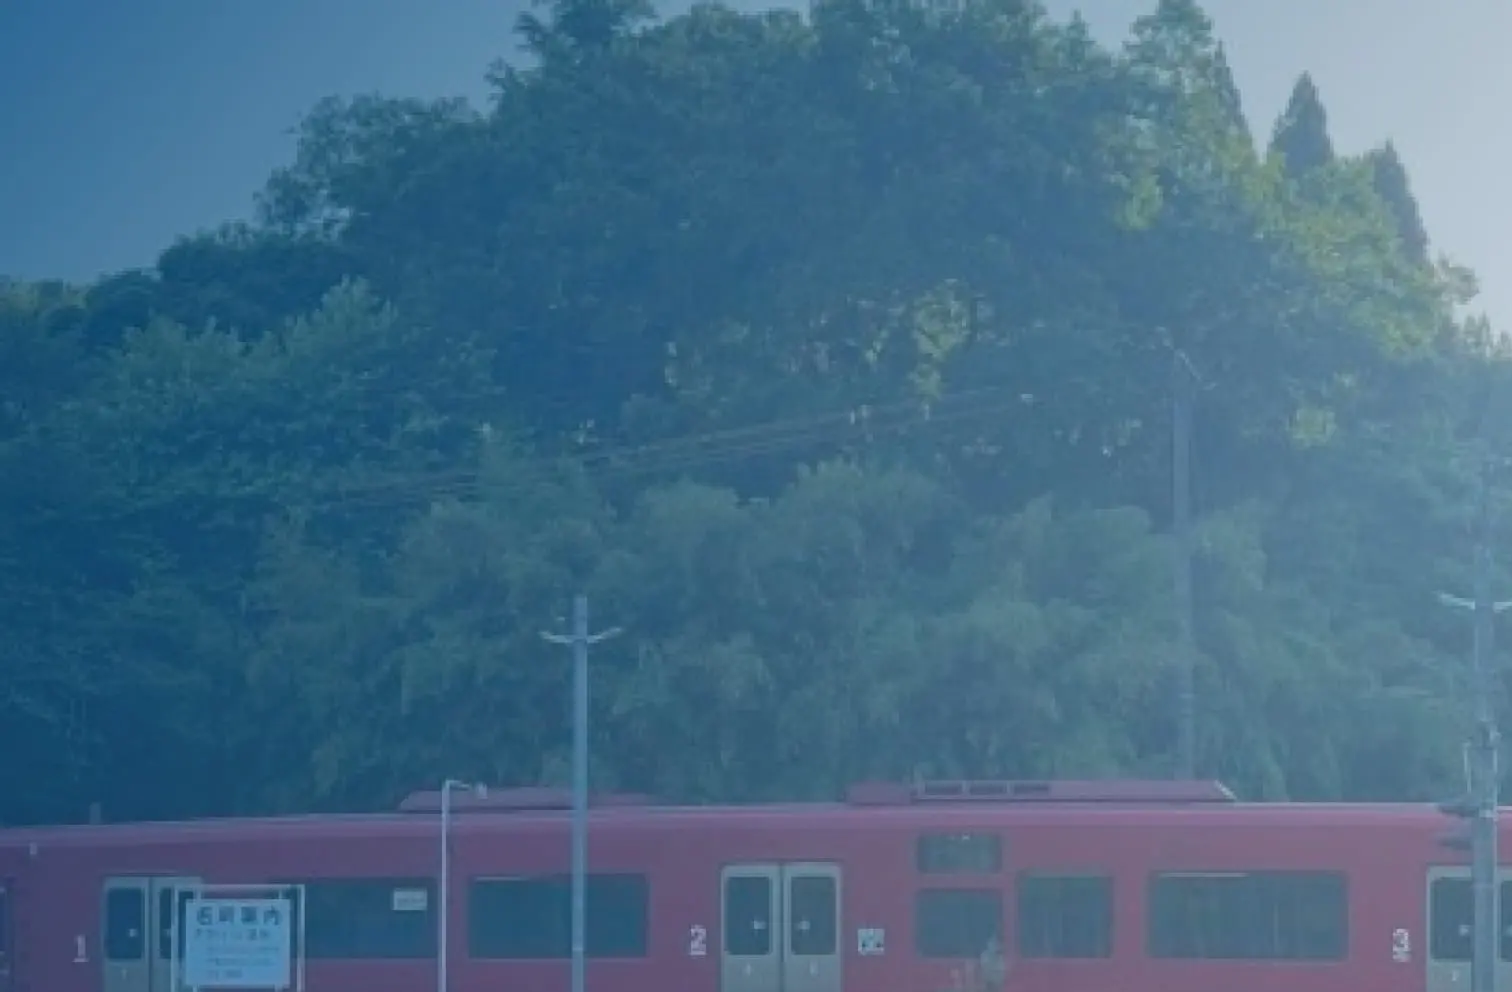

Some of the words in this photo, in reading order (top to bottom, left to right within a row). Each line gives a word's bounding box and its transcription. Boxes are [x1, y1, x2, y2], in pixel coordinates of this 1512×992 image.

[72, 934, 89, 963] 1
[690, 925, 707, 956] 2
[1392, 928, 1409, 962] 3
